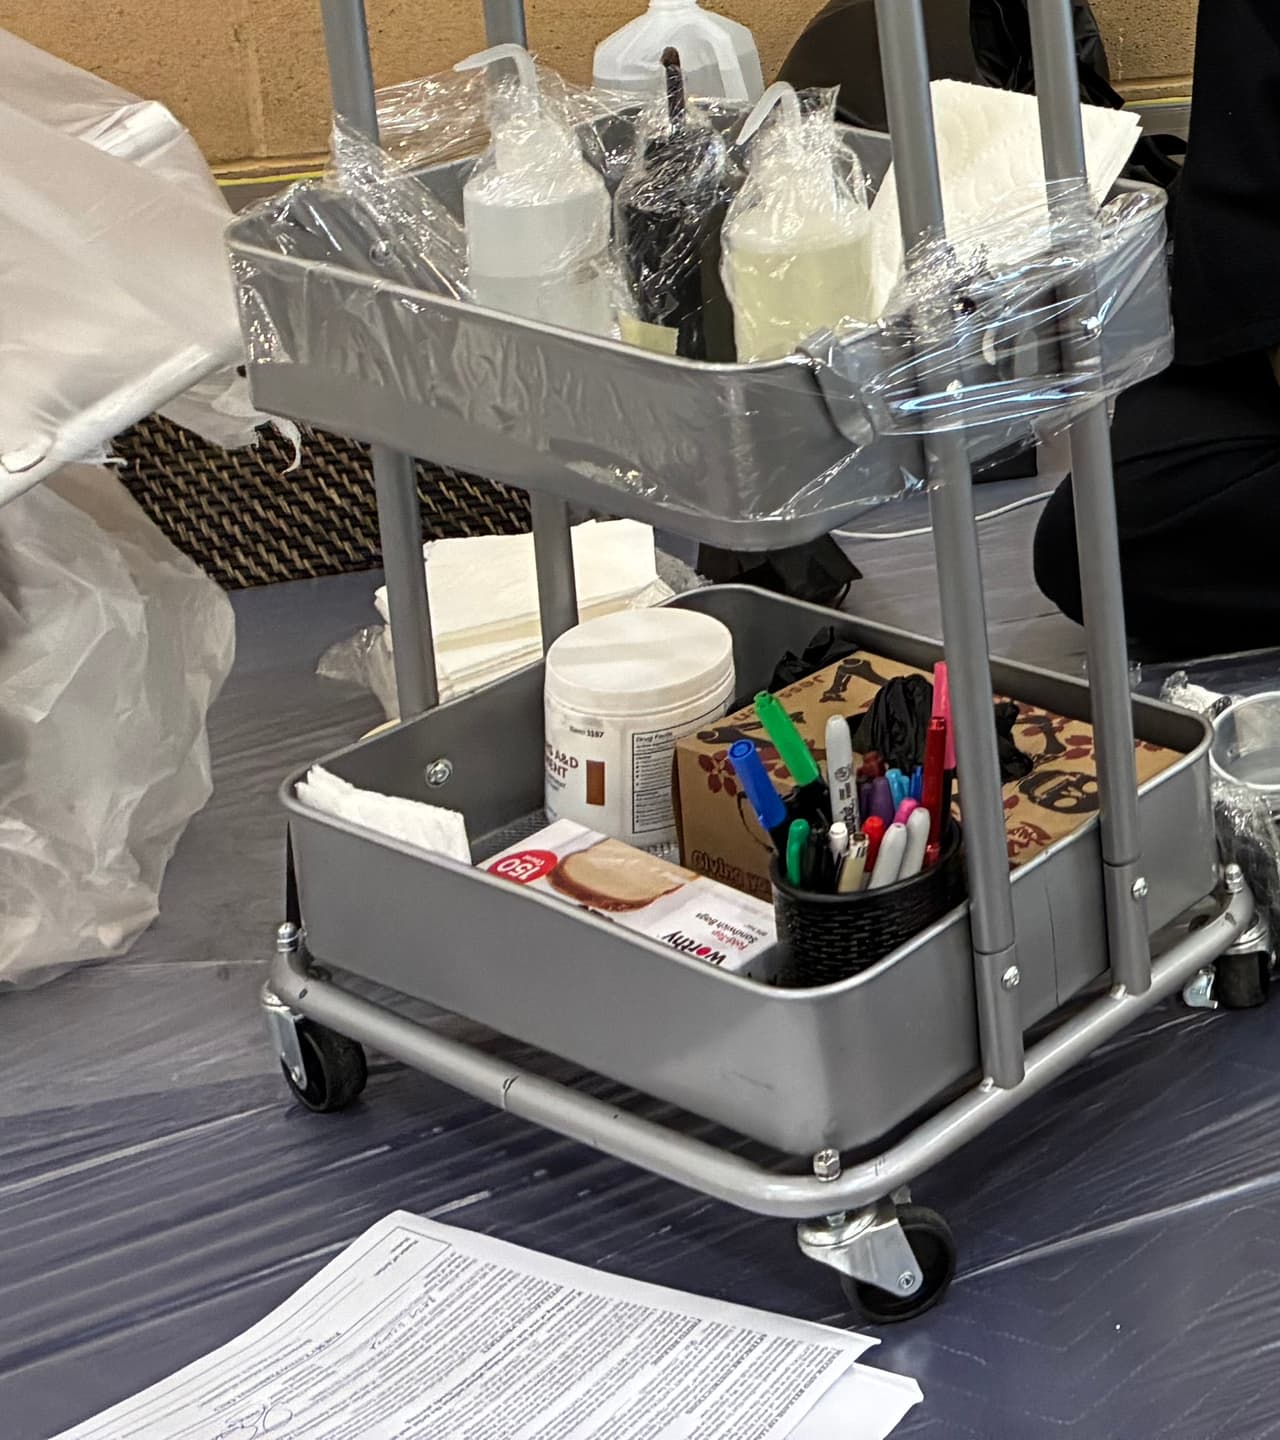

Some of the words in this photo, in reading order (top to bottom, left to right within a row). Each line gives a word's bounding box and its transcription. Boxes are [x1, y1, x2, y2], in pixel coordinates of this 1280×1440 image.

[498, 861, 538, 881] 150
[716, 920, 759, 945] Sandwich
[662, 930, 727, 966] worthy
